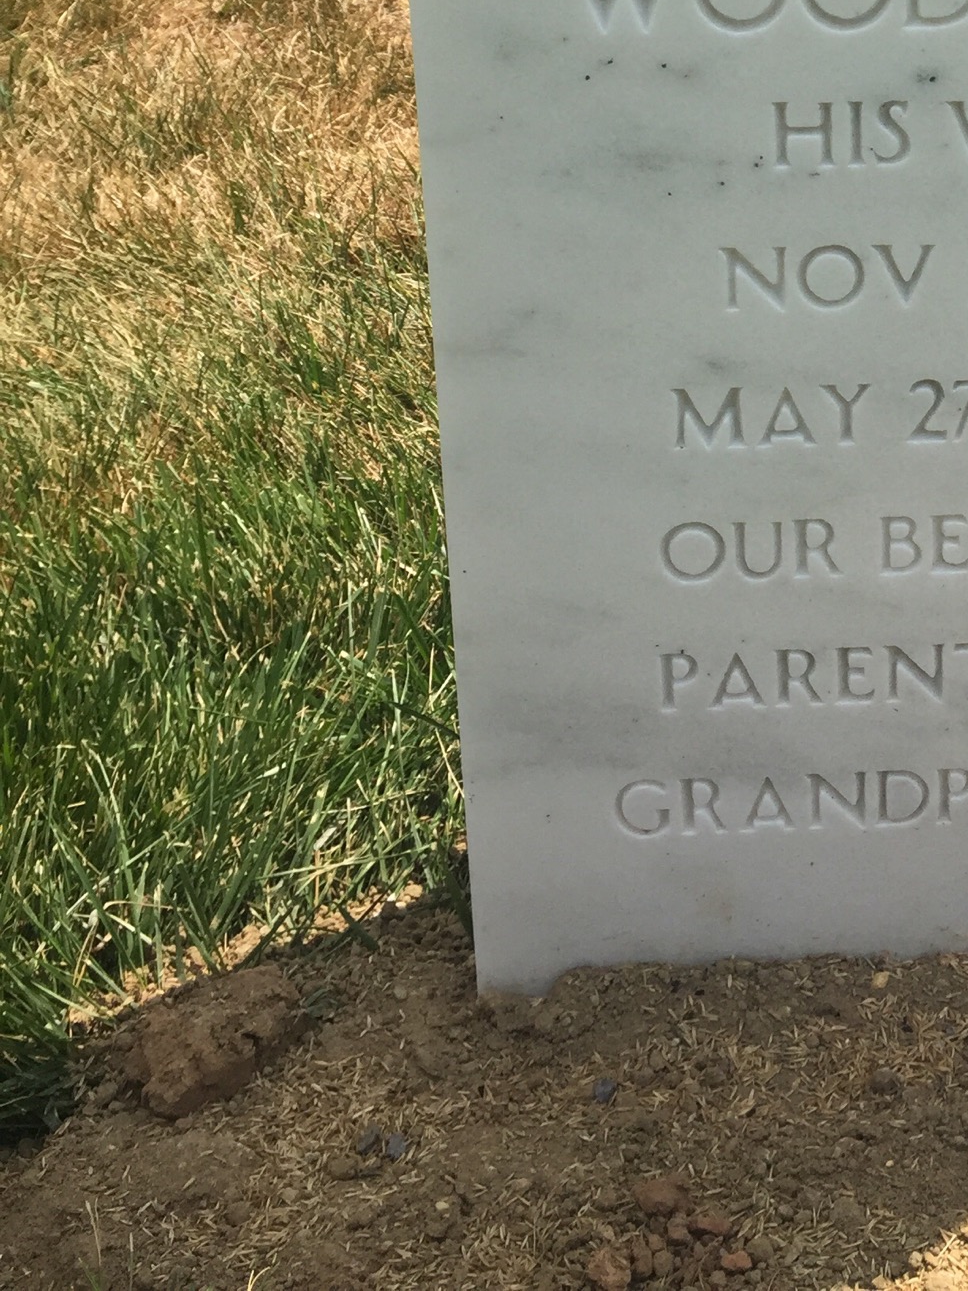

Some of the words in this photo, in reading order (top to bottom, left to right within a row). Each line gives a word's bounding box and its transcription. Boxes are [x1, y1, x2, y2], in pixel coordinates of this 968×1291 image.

[772, 100, 912, 168] HIS
[718, 243, 935, 311] NOV
[670, 382, 870, 449] MAY
[660, 517, 843, 583] OUR
